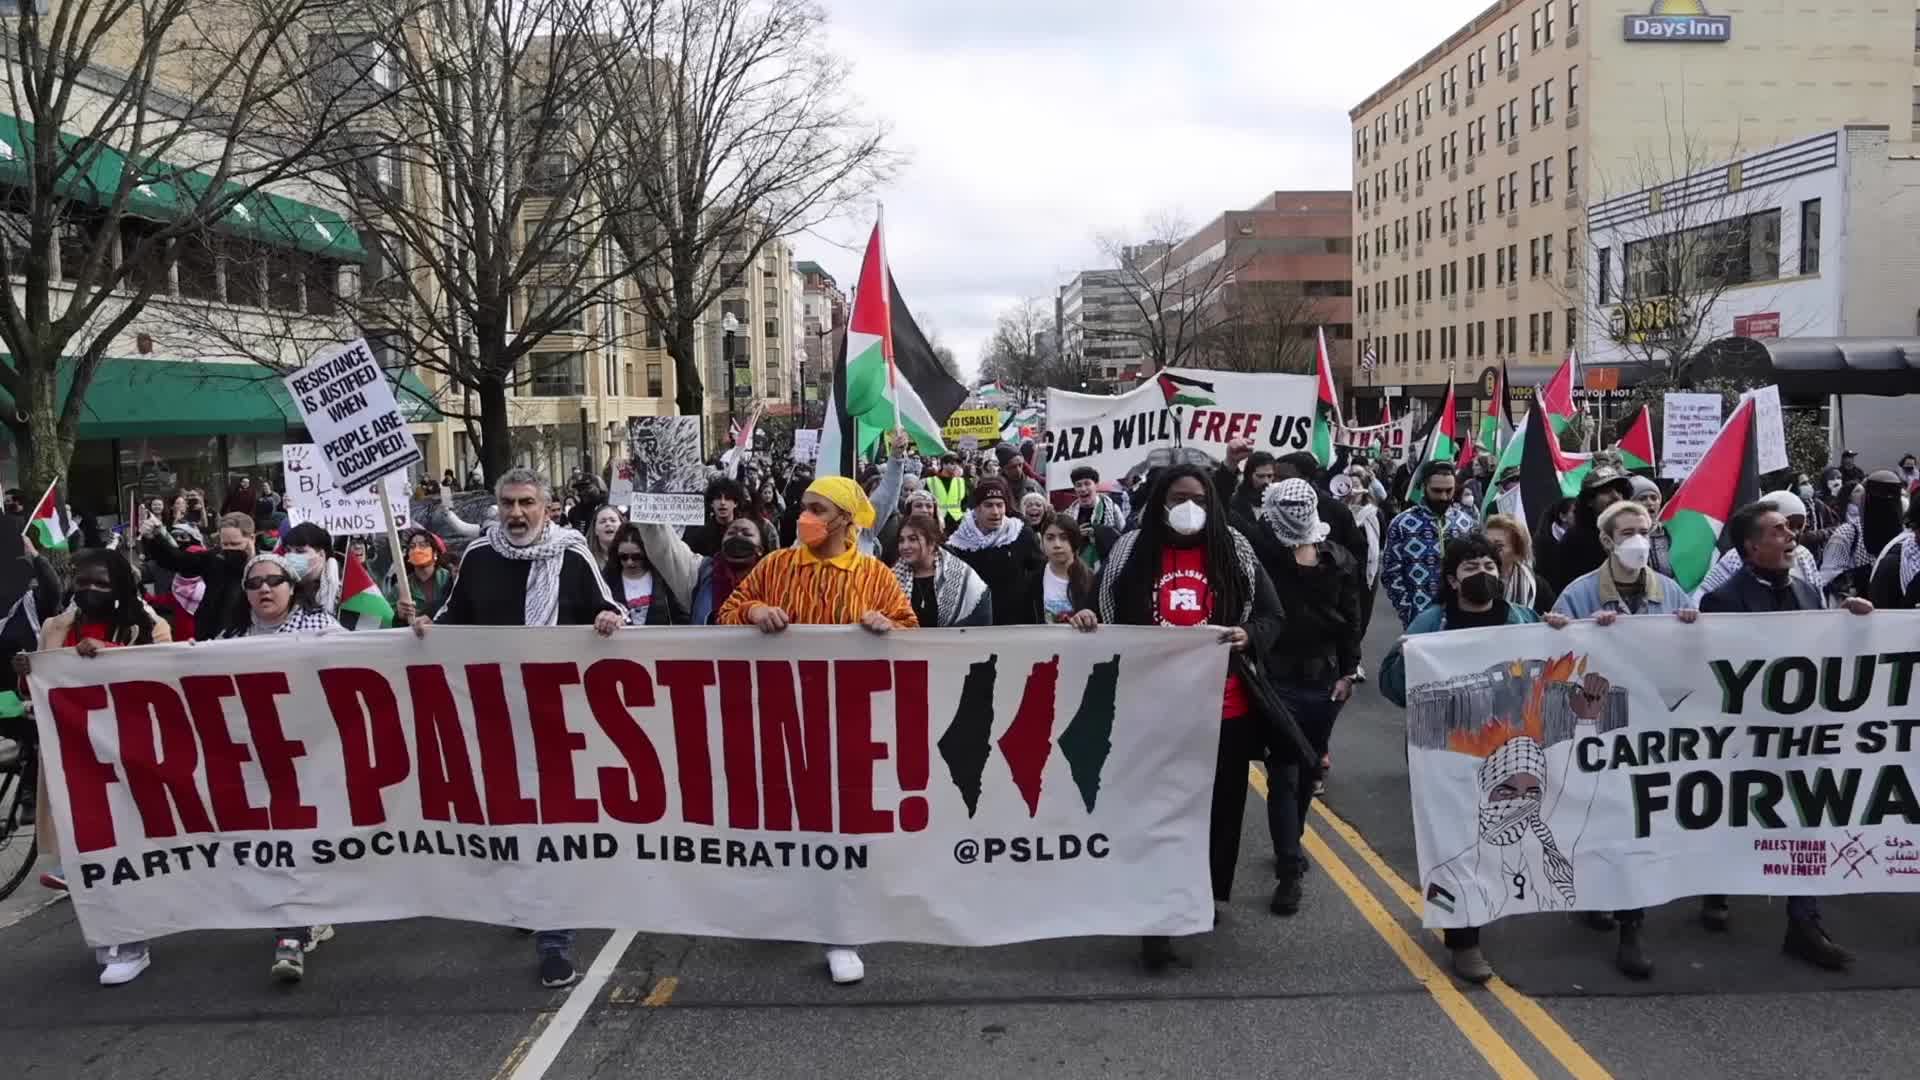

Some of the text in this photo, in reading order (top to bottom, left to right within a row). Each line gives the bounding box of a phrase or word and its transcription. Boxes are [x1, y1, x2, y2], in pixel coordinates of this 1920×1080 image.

[1634, 20, 1724, 37] Days Inn
[292, 345, 371, 396] RESISTANCE
[302, 365, 378, 415] IS JUSTIFIED
[327, 392, 368, 423] WHEN
[961, 415, 993, 426] ISRAEL!
[323, 410, 403, 462] PEOPLE ARE
[1113, 408, 1170, 450] WILL
[1187, 410, 1262, 445] FREE
[1268, 415, 1311, 449] US
[337, 431, 408, 478] OCCUPIED!
[321, 497, 380, 509] is on your
[324, 515, 376, 531] HANDS
[1169, 588, 1201, 611] PSL
[49, 659, 929, 853] FREE PALESTINE!
[1576, 726, 1736, 773] CARRY
[1746, 723, 1845, 760] THE
[81, 830, 1111, 889] PARTY FOR SOCIALISM AND LIBERATION @PSLDC
[1754, 839, 1827, 851] PALESTINIAN
[1790, 852, 1827, 864] YOUTH
[1763, 864, 1827, 876] MOVEMENT
